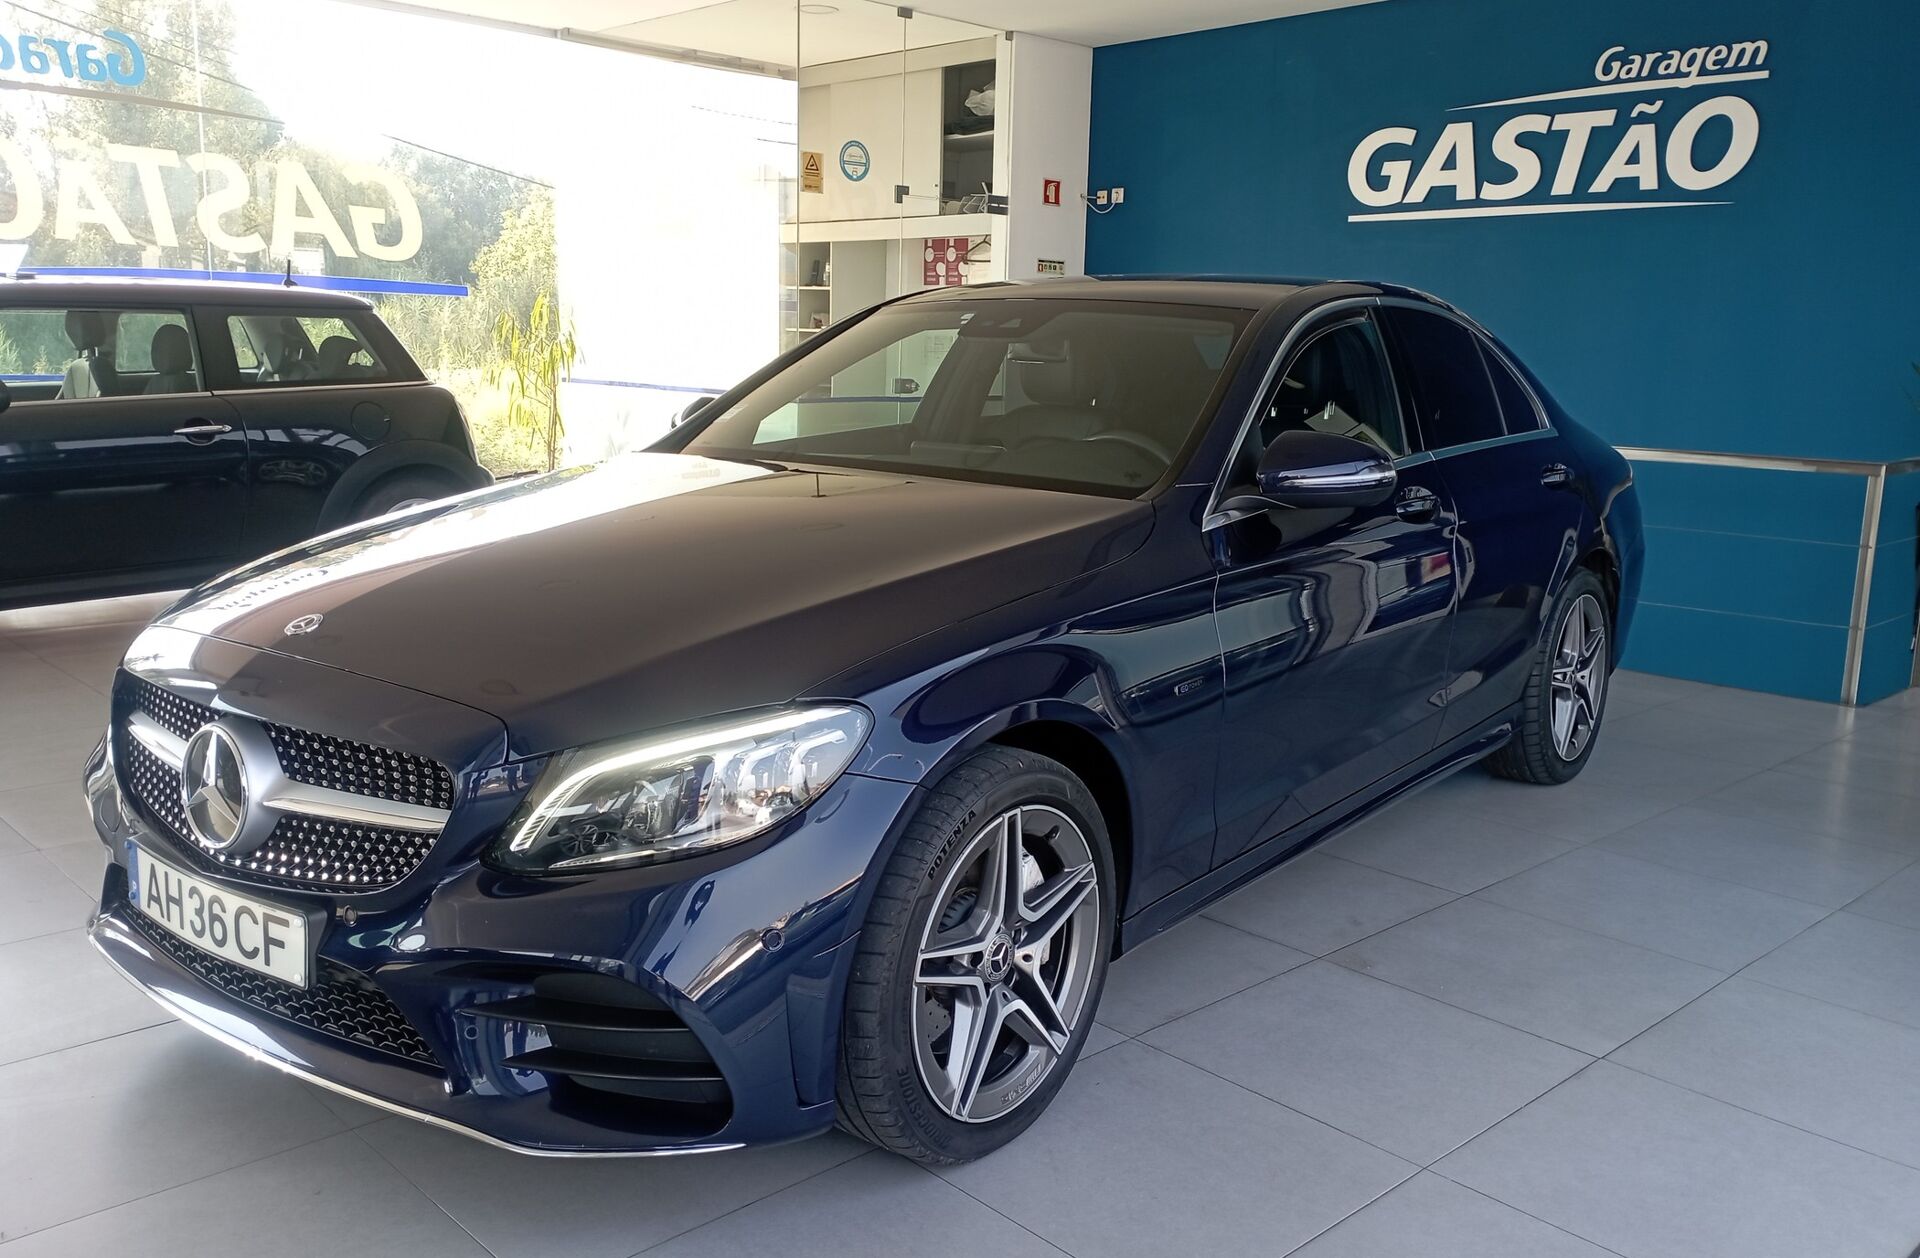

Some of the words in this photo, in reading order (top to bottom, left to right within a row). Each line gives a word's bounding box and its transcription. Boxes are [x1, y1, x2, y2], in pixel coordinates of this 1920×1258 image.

[1594, 40, 1768, 88] Garagem
[1347, 95, 1760, 207] GASTÃO
[928, 810, 976, 880] POTENZA
[147, 863, 289, 966] AH36CF
